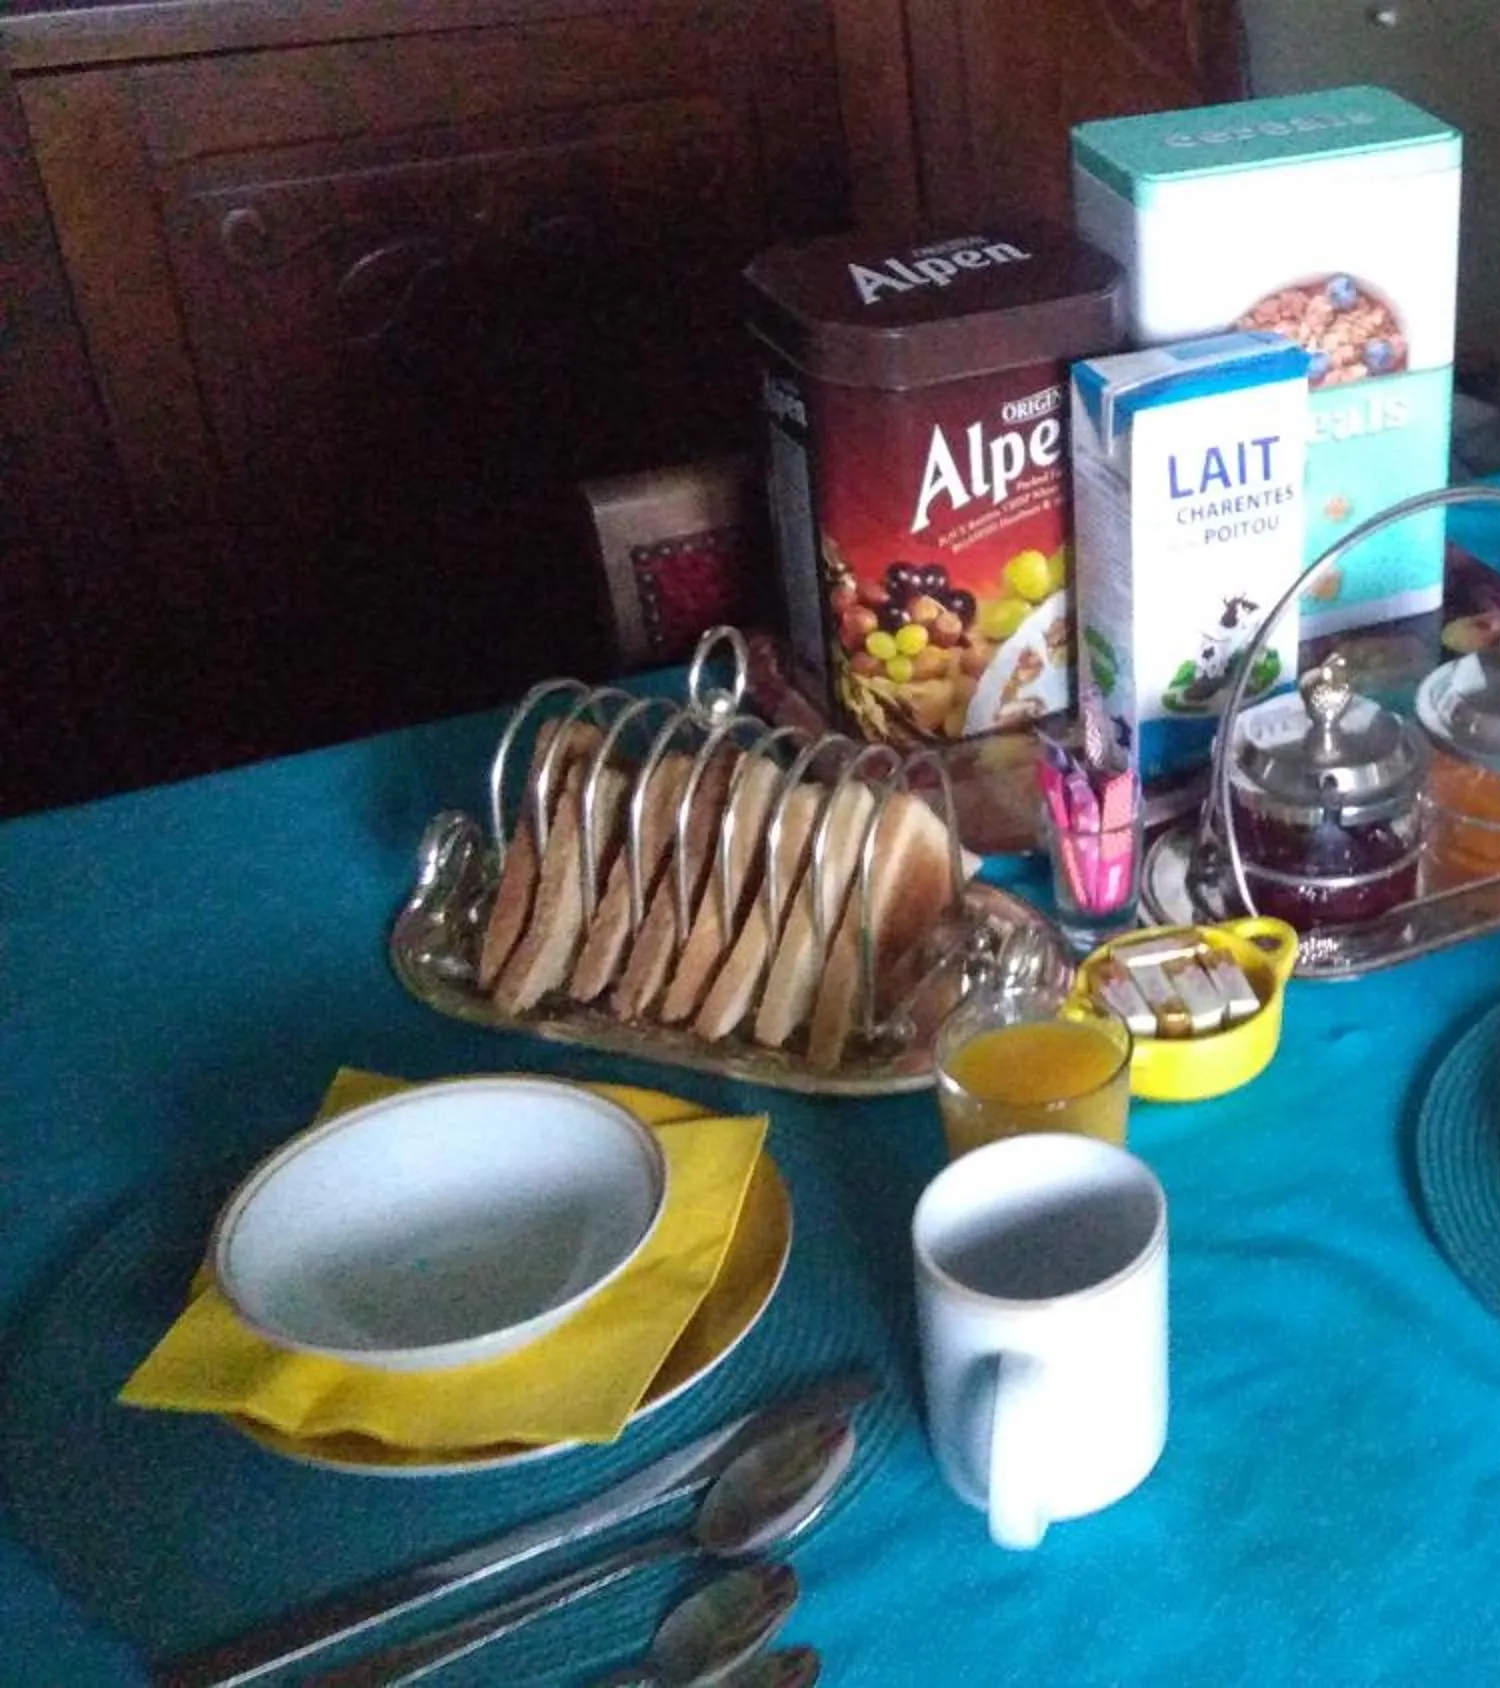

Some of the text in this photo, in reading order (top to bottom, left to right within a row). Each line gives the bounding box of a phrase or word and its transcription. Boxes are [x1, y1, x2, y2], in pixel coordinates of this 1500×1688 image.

[848, 243, 1032, 305] Alpen
[1304, 396, 1410, 443] eals
[910, 418, 1061, 535] Alpe
[1168, 435, 1280, 499] LAIT
[1176, 485, 1294, 525] CHARENTES
[1205, 515, 1280, 545] POITOU
